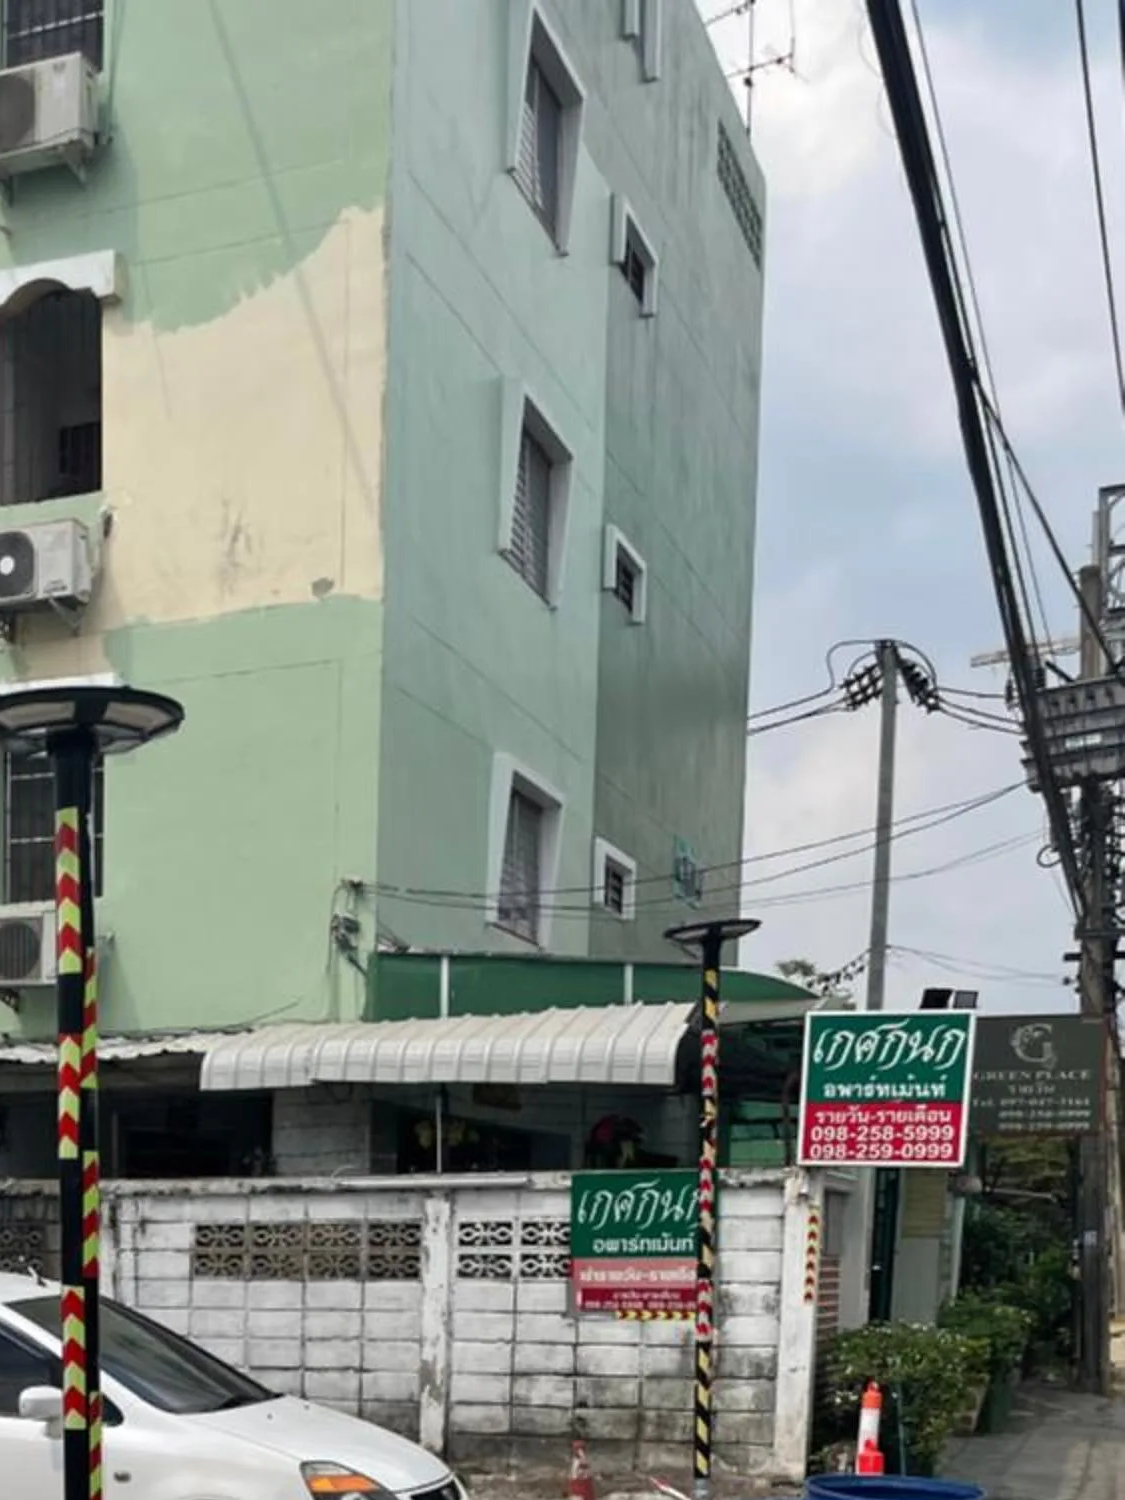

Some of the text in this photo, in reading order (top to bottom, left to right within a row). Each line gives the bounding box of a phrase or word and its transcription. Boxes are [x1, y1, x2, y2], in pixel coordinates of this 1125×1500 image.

[814, 1104, 953, 1123] รายวัน-รายเดือน
[810, 1125, 954, 1142] 098-258-5999
[809, 1143, 953, 1160] 098-259-0999
